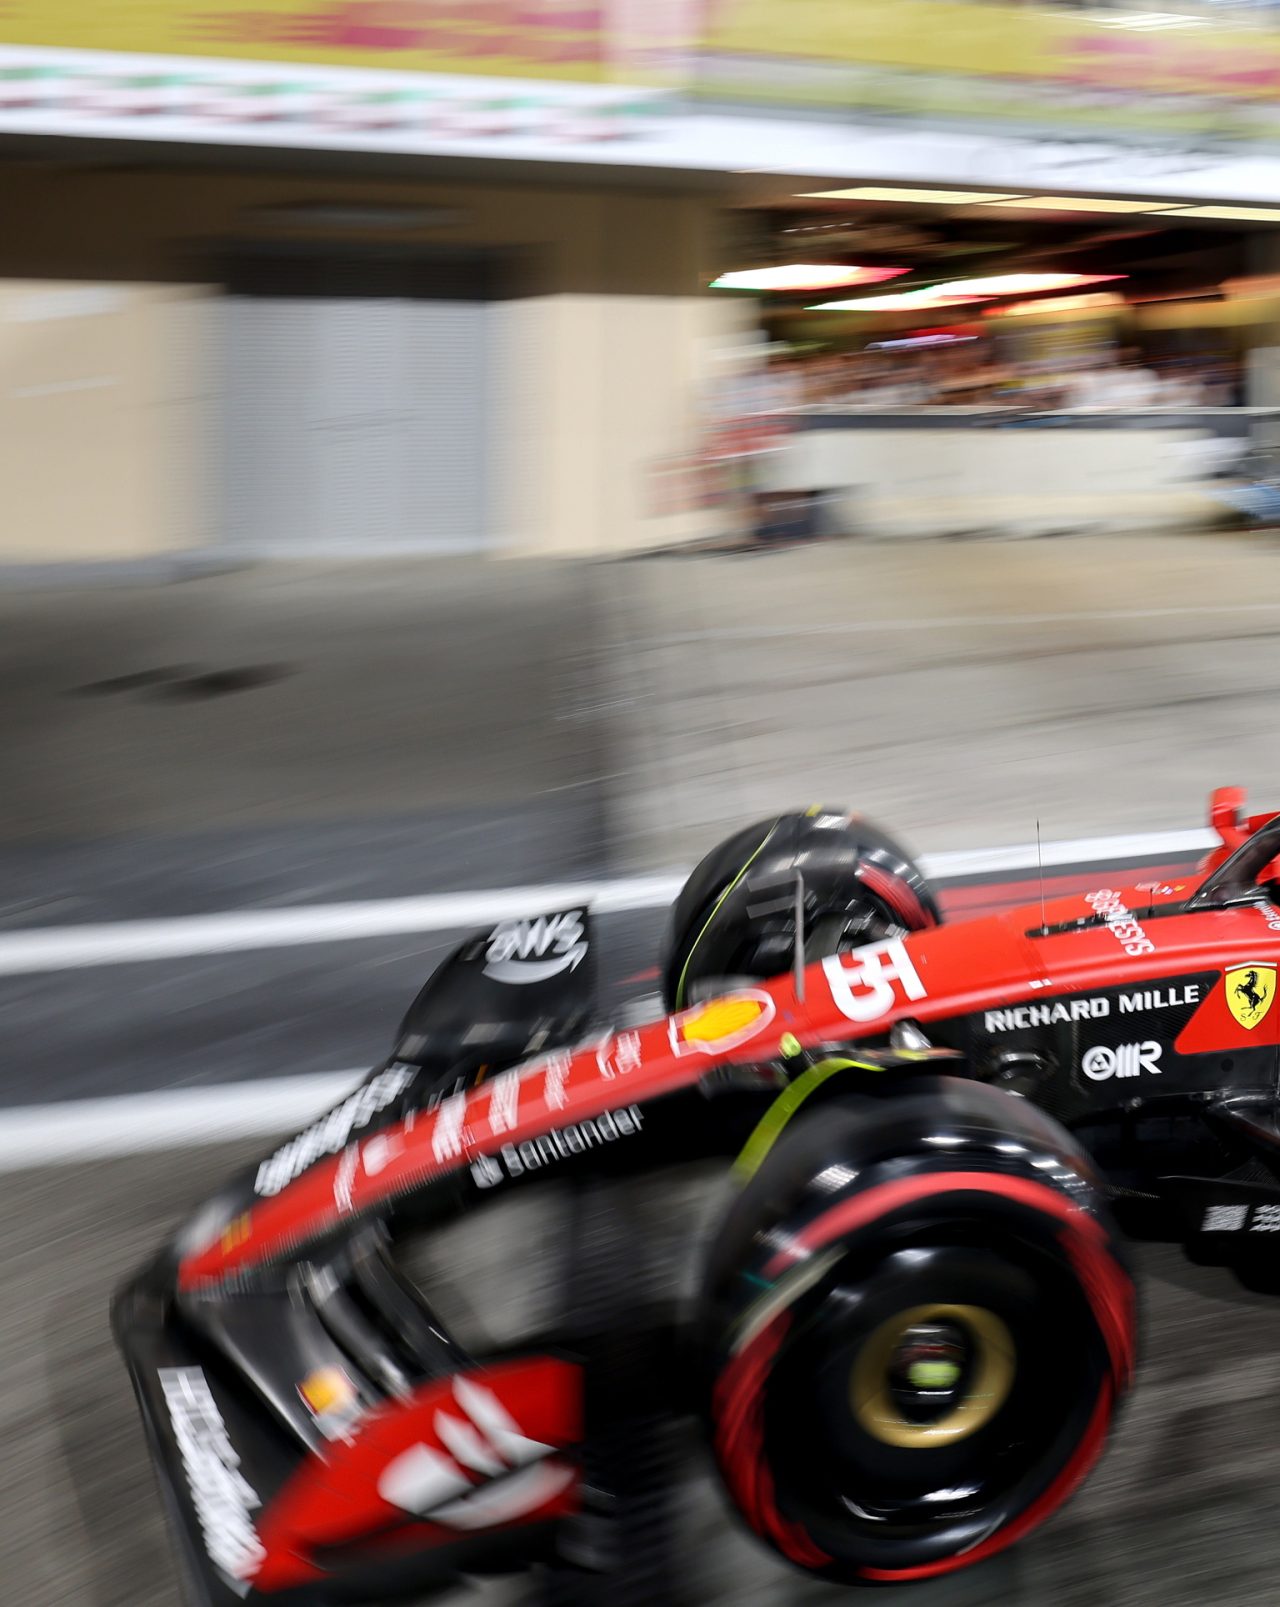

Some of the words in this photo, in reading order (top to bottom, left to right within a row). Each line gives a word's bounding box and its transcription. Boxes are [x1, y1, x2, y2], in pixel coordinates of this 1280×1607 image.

[984, 997, 1111, 1034] RICHARD
[1118, 984, 1200, 1014] MILLE
[500, 1103, 645, 1178] Santander
